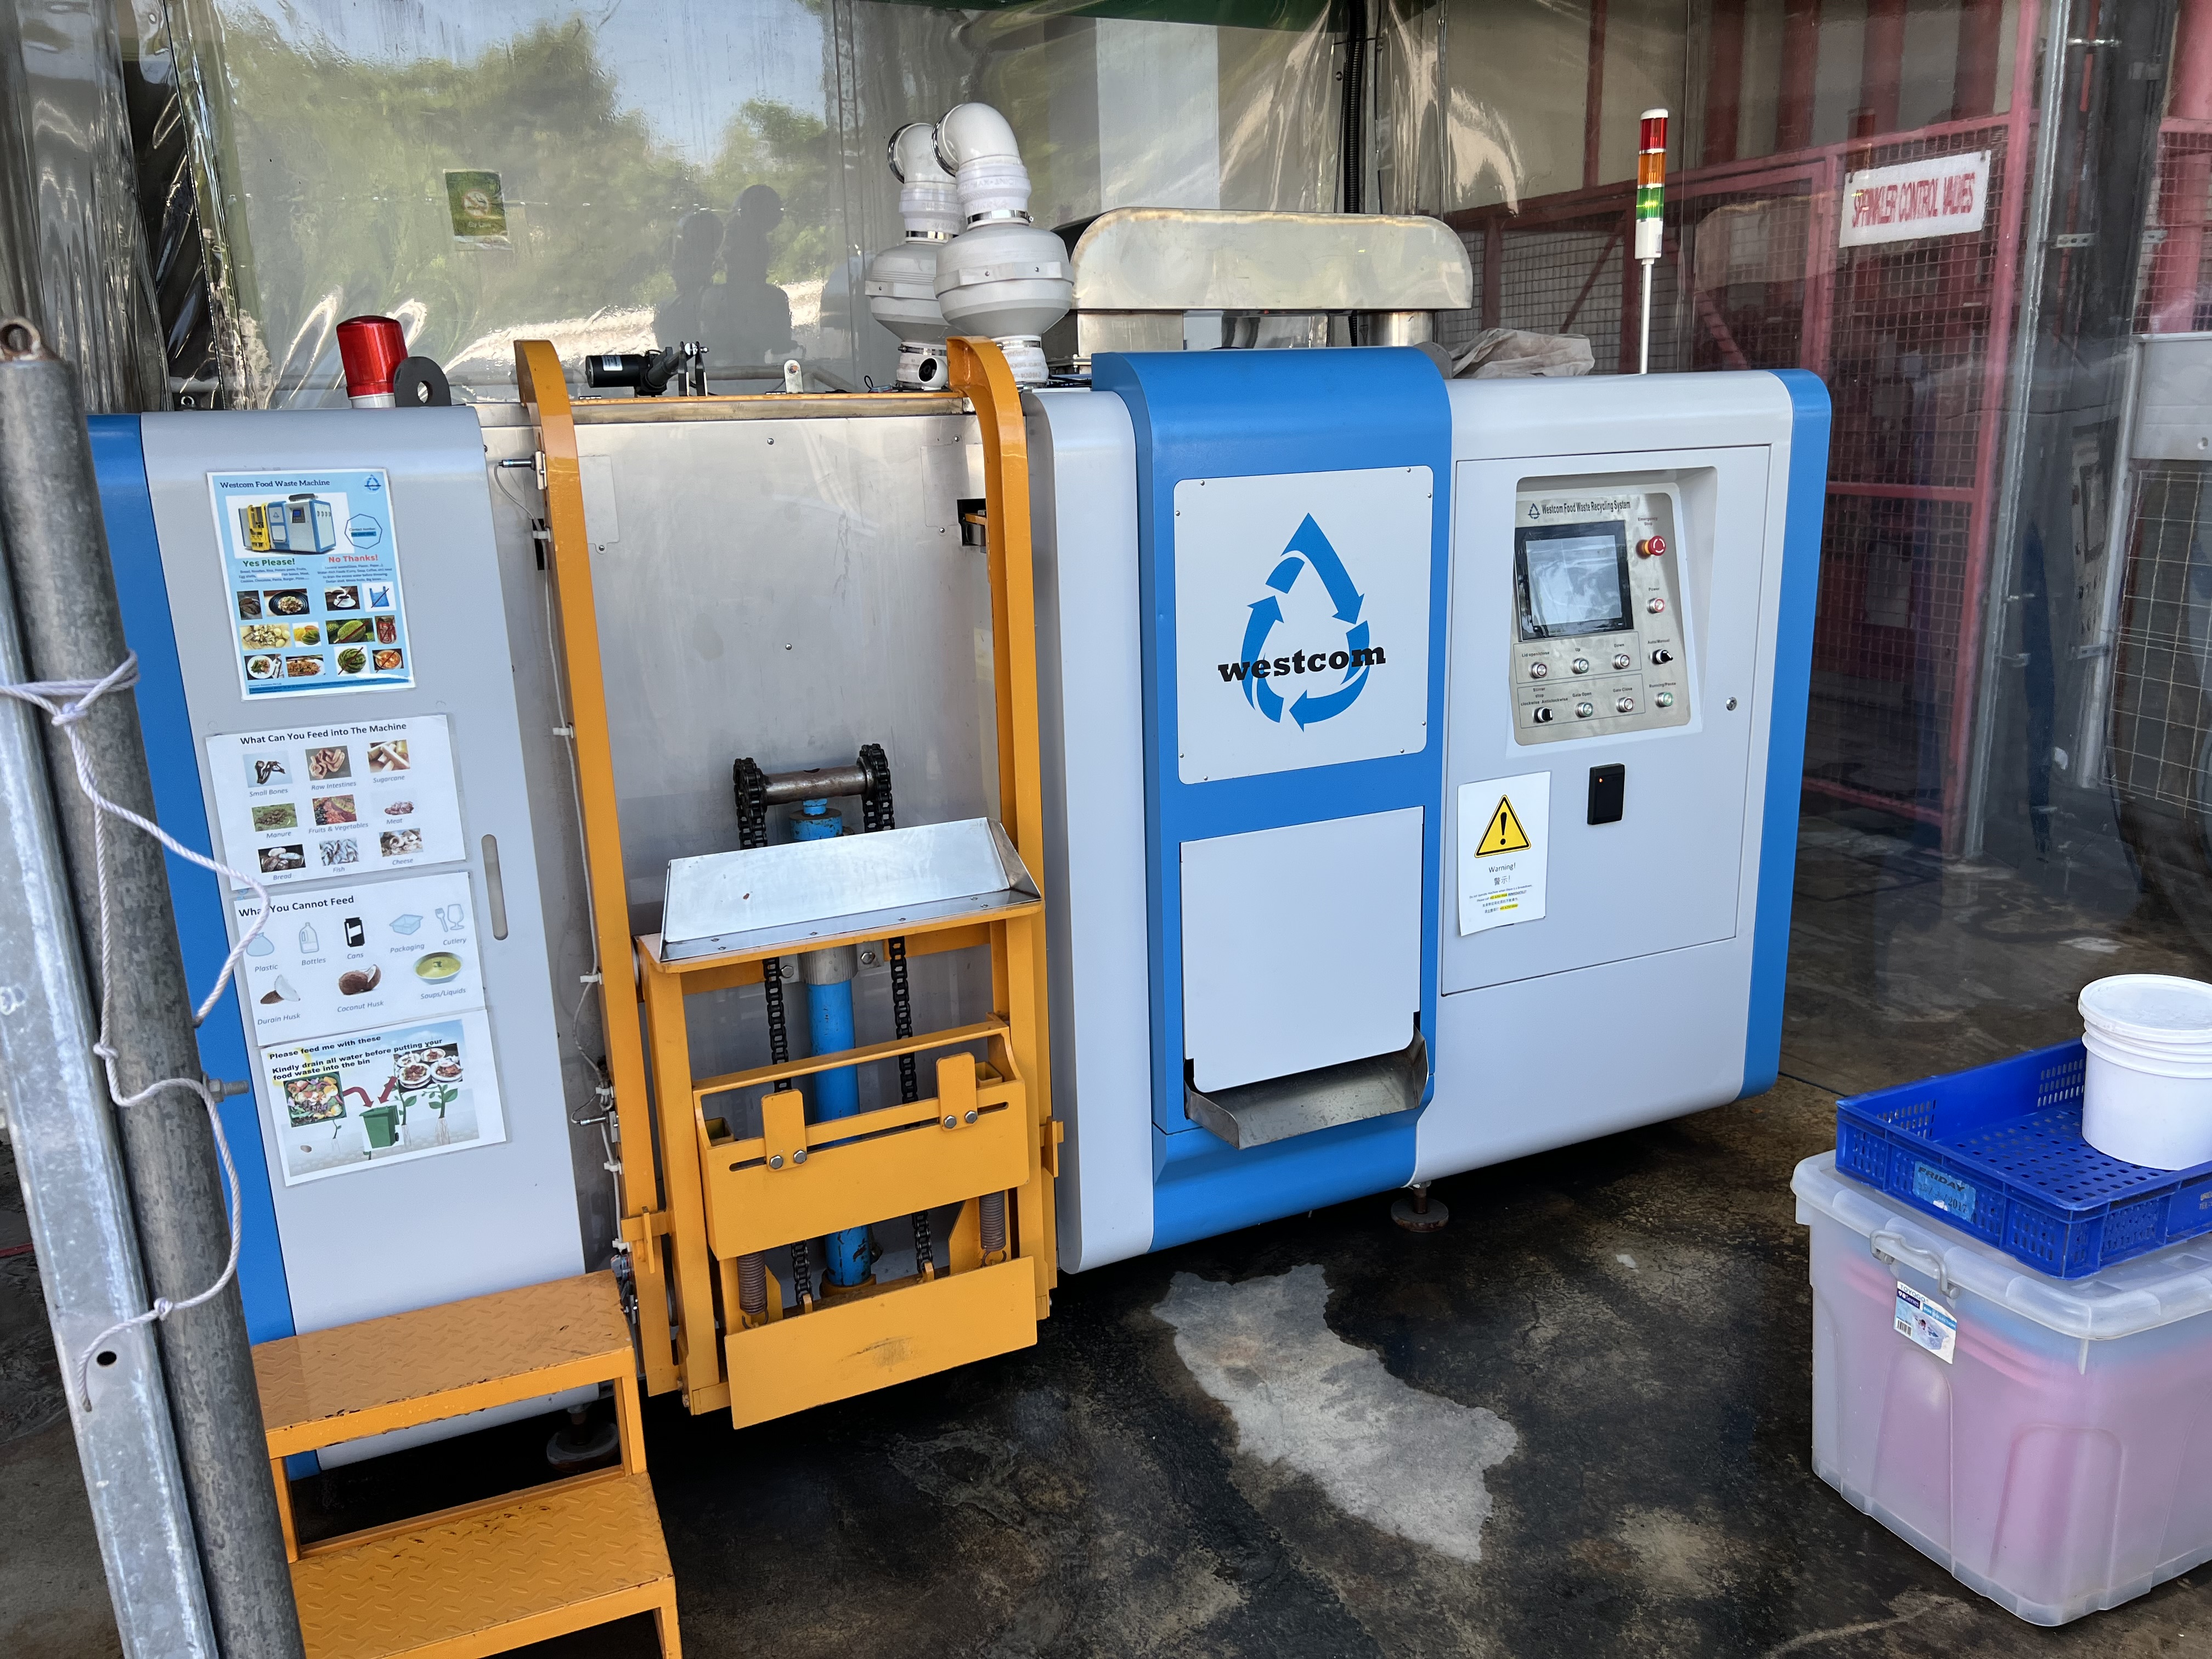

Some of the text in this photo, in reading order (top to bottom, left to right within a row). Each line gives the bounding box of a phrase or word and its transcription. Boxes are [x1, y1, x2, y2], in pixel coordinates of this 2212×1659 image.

[1542, 500, 1631, 514] Westcom Food Waste Recycling System
[262, 558, 295, 566] Please!
[1218, 646, 1386, 682] westcom
[240, 736, 266, 744] What
[307, 730, 328, 738] Feed
[351, 726, 367, 735] The
[369, 723, 407, 732] Machine
[373, 775, 405, 783] Sugarcane
[335, 822, 368, 832] Vegetables
[1488, 862, 1516, 873] Warning!
[239, 907, 262, 917] Wha
[292, 900, 328, 910] Cannot
[331, 895, 354, 905] Feed
[443, 937, 466, 946] Cutlery
[390, 943, 425, 953] Packaging
[301, 957, 326, 966] Bottles
[255, 964, 278, 972] Plastic
[420, 988, 466, 1000] Soups/Liquids
[337, 1000, 384, 1013] Coconut Husk
[257, 1013, 300, 1025] Durain Husk
[269, 1049, 298, 1059] Please
[301, 1046, 319, 1054] feed
[337, 1040, 356, 1048] with
[358, 1035, 381, 1044] these
[272, 1064, 300, 1074] Kindly
[302, 1060, 324, 1069] drain
[339, 1053, 363, 1062] water
[365, 1048, 392, 1057] before
[393, 1042, 422, 1053] putting
[425, 1039, 442, 1047] your
[273, 1072, 292, 1081] food
[295, 1067, 320, 1076] waste
[323, 1064, 339, 1072] into
[1918, 1167, 1965, 1192] FRIDAY
